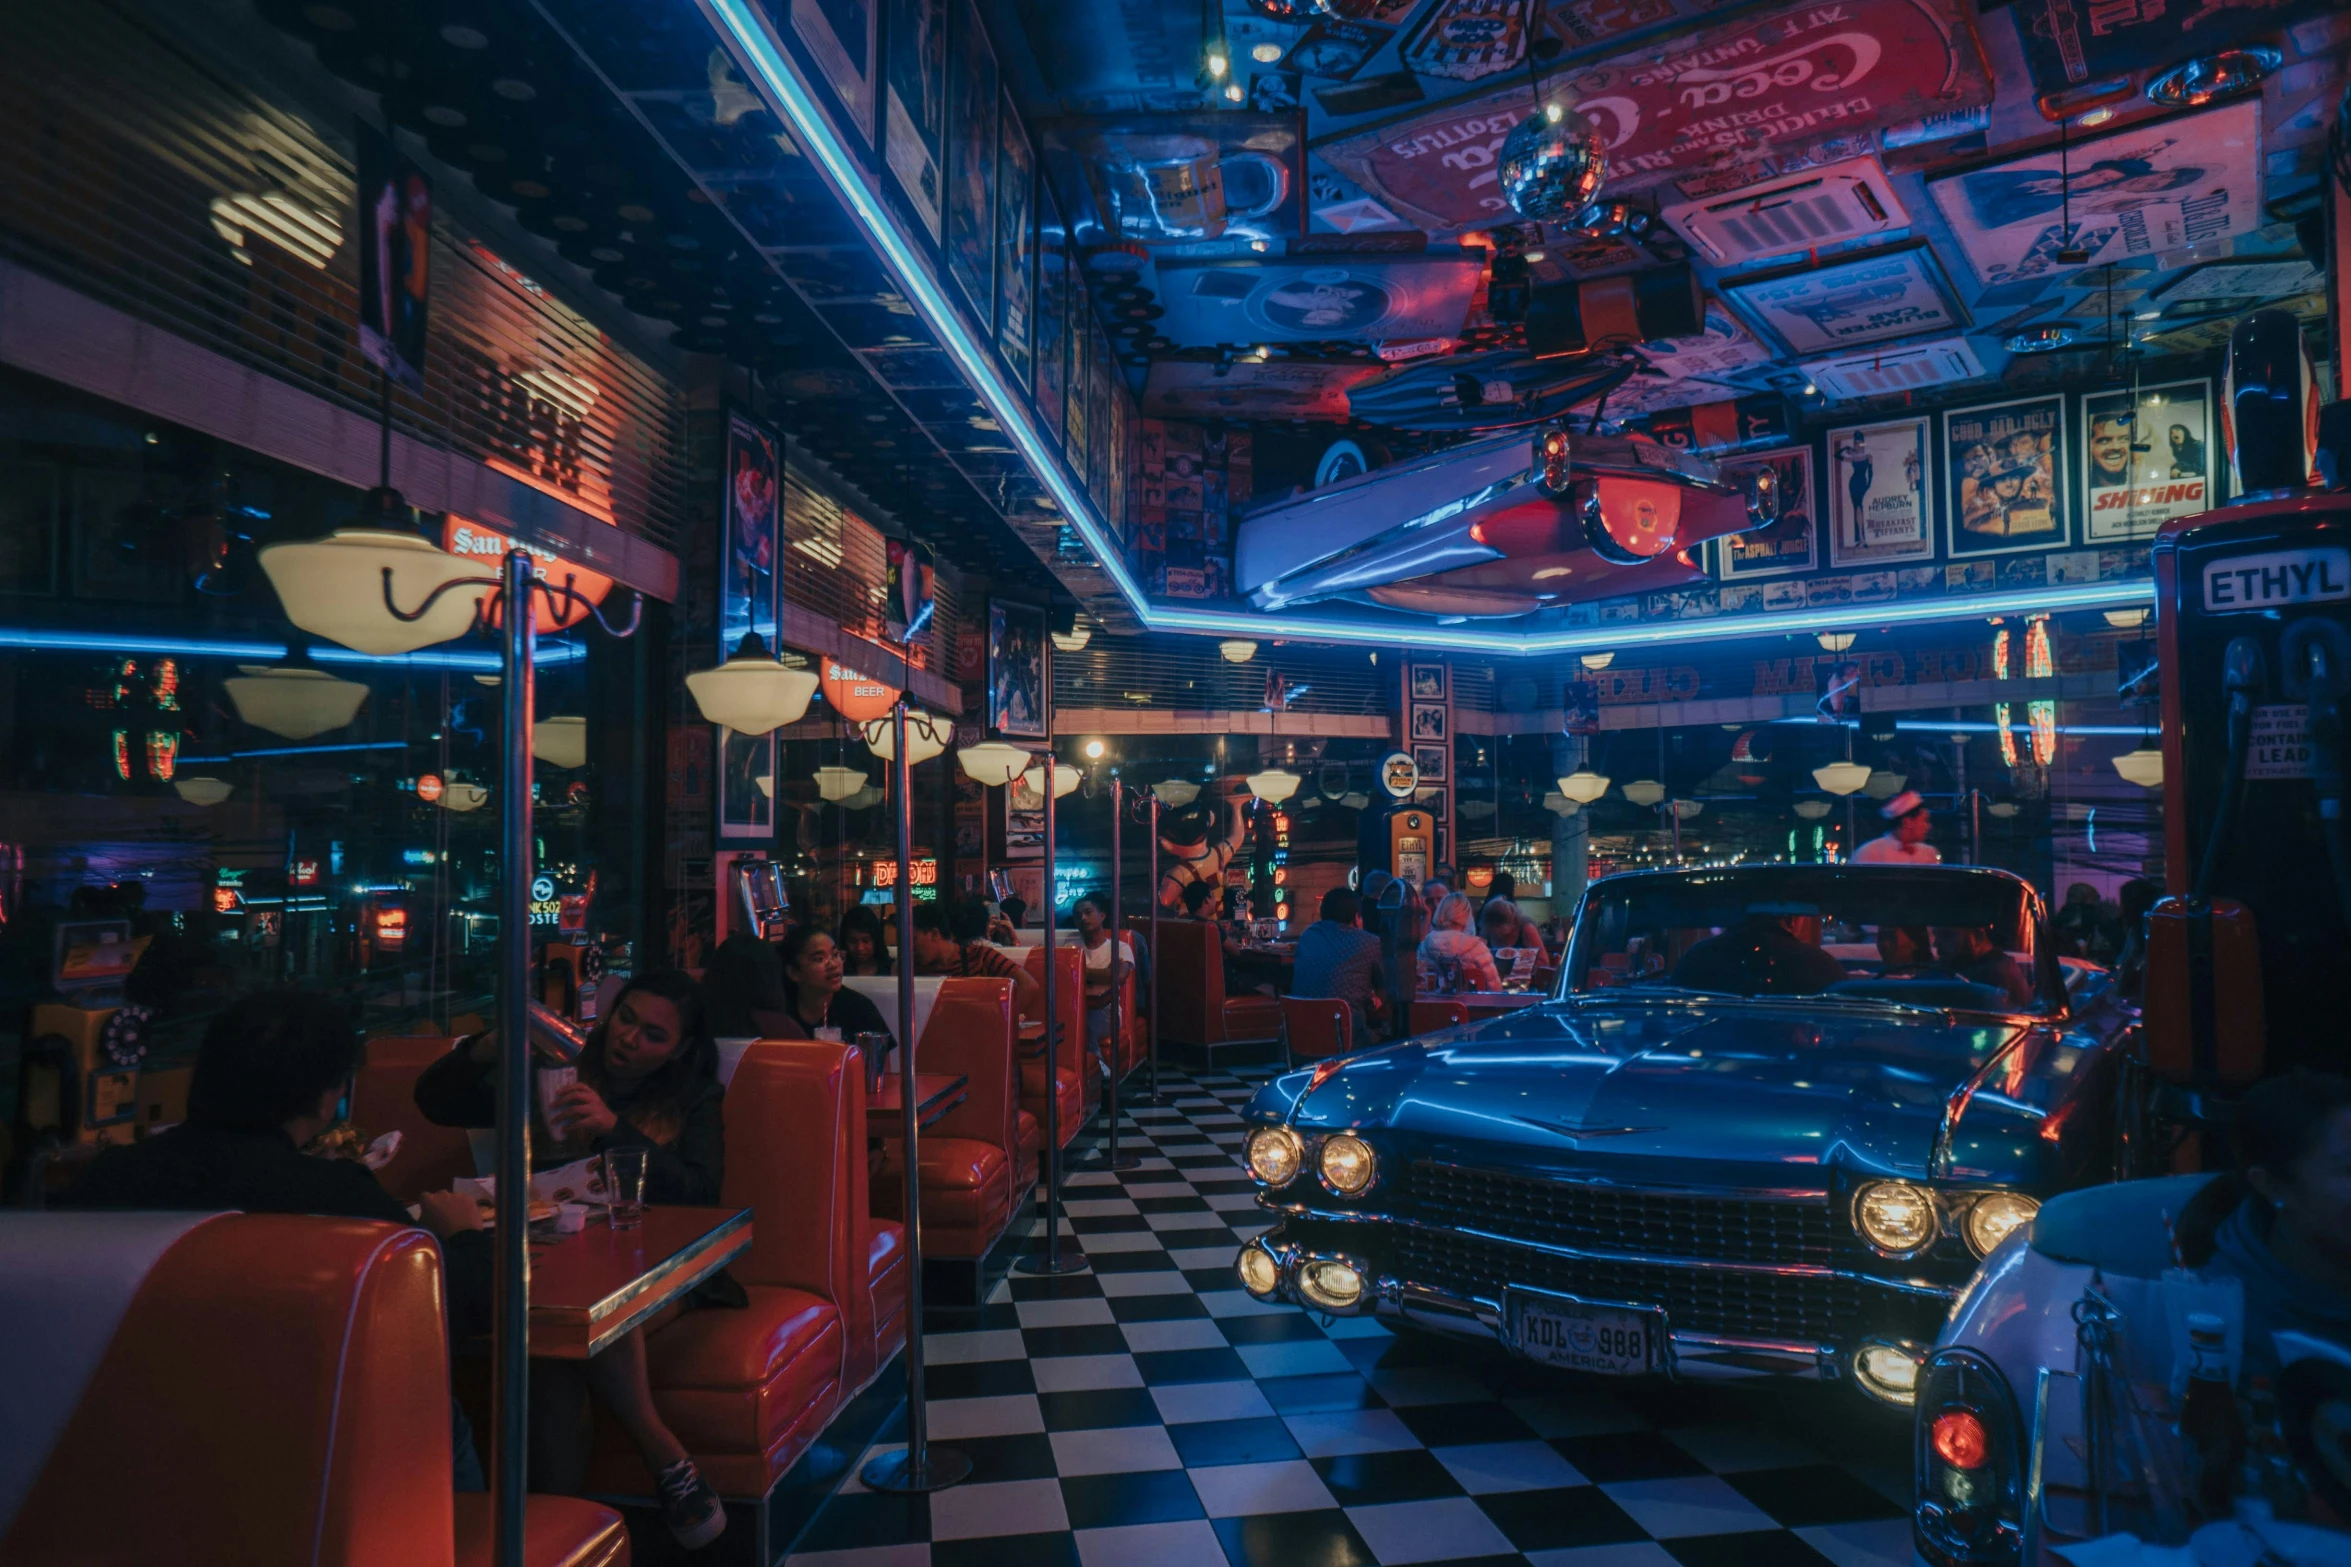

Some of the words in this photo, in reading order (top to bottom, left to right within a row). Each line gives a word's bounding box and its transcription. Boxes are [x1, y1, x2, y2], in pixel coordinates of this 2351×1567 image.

[1630, 18, 1804, 87] FUNTAINS
[1676, 101, 1791, 138] DRINK
[1713, 96, 1873, 148] DELICIUS
[1835, 309, 1941, 336] BUMPER
[1866, 305, 1921, 323] CAR
[1868, 501, 1913, 512] HEPBURN
[1872, 494, 1909, 505] AUDREY
[1866, 516, 1916, 530] BREAKFAST
[452, 527, 503, 556] San
[1744, 542, 1777, 559] ASPHALT
[2210, 560, 2344, 605] ETHYL
[854, 686, 885, 697] BEER
[2272, 709, 2291, 718] USE
[2275, 720, 2300, 729] FUEL
[2259, 748, 2310, 764] LEAD
[1401, 839, 1423, 851] ETHYL
[1526, 1315, 1567, 1349] KDL
[1599, 1327, 1641, 1359] 988
[1547, 1351, 1616, 1370] AMERICA
